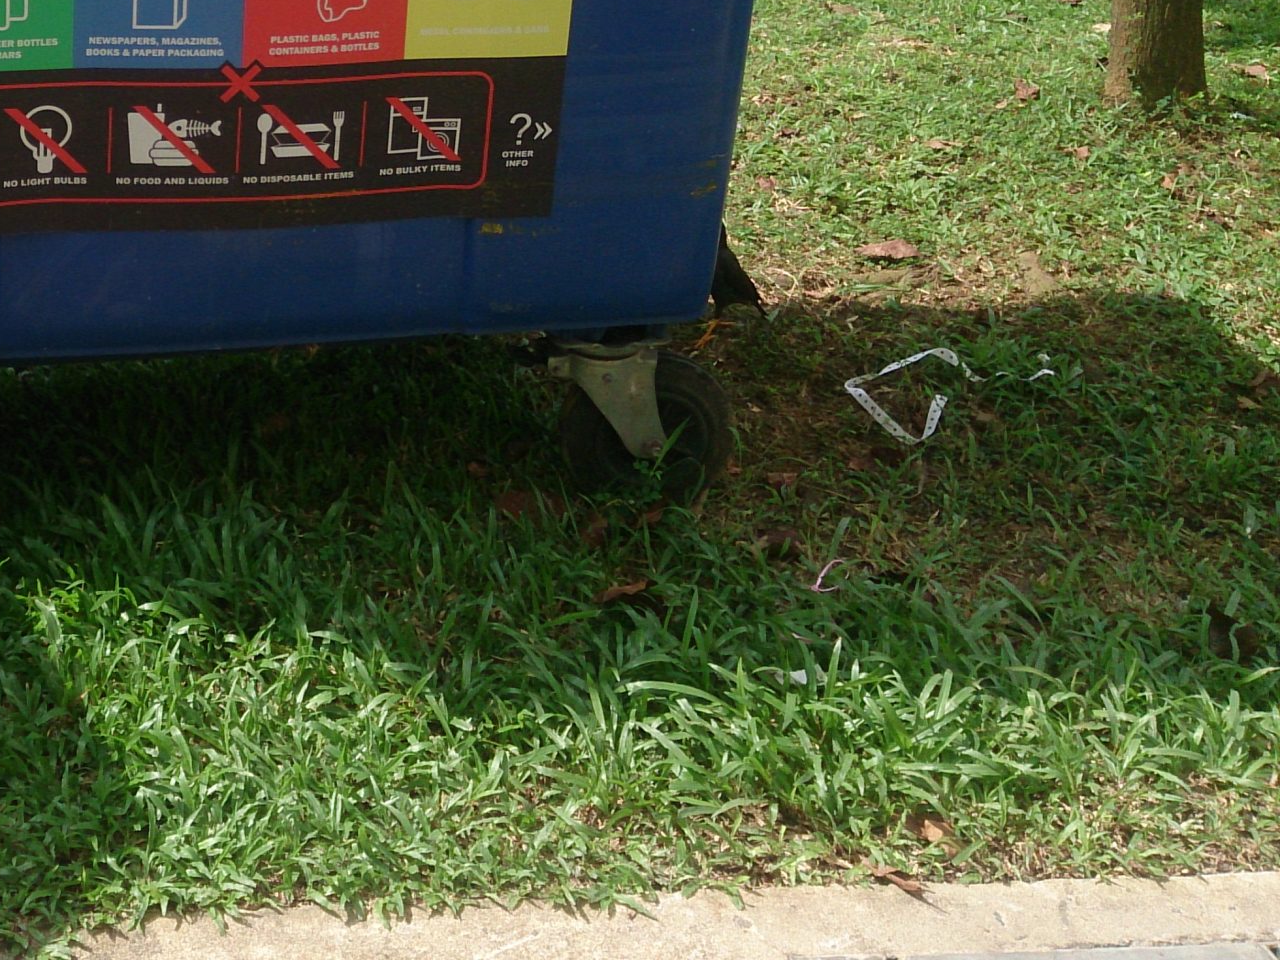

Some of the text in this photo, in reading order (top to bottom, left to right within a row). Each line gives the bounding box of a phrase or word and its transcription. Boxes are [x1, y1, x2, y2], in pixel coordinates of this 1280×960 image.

[88, 37, 222, 46] NEWSPAPERS, MAGAZINES,
[270, 31, 380, 44] PLASTIC BAGS, PLASTIC
[17, 38, 58, 47] BOTTLES
[86, 48, 224, 57] BOOKS & PAPER PACKAGING
[269, 42, 380, 55] CONTAINERS & BOTTLES
[501, 150, 534, 159] OTHER
[505, 159, 528, 167] INFO
[379, 164, 462, 176] NO BULKY ITEMS
[3, 176, 88, 188] NO LIGHT BULBS
[115, 177, 229, 185] NO FOOD AND LIQUIDS
[242, 171, 354, 184] NO DISPOSABLE ITEMS
